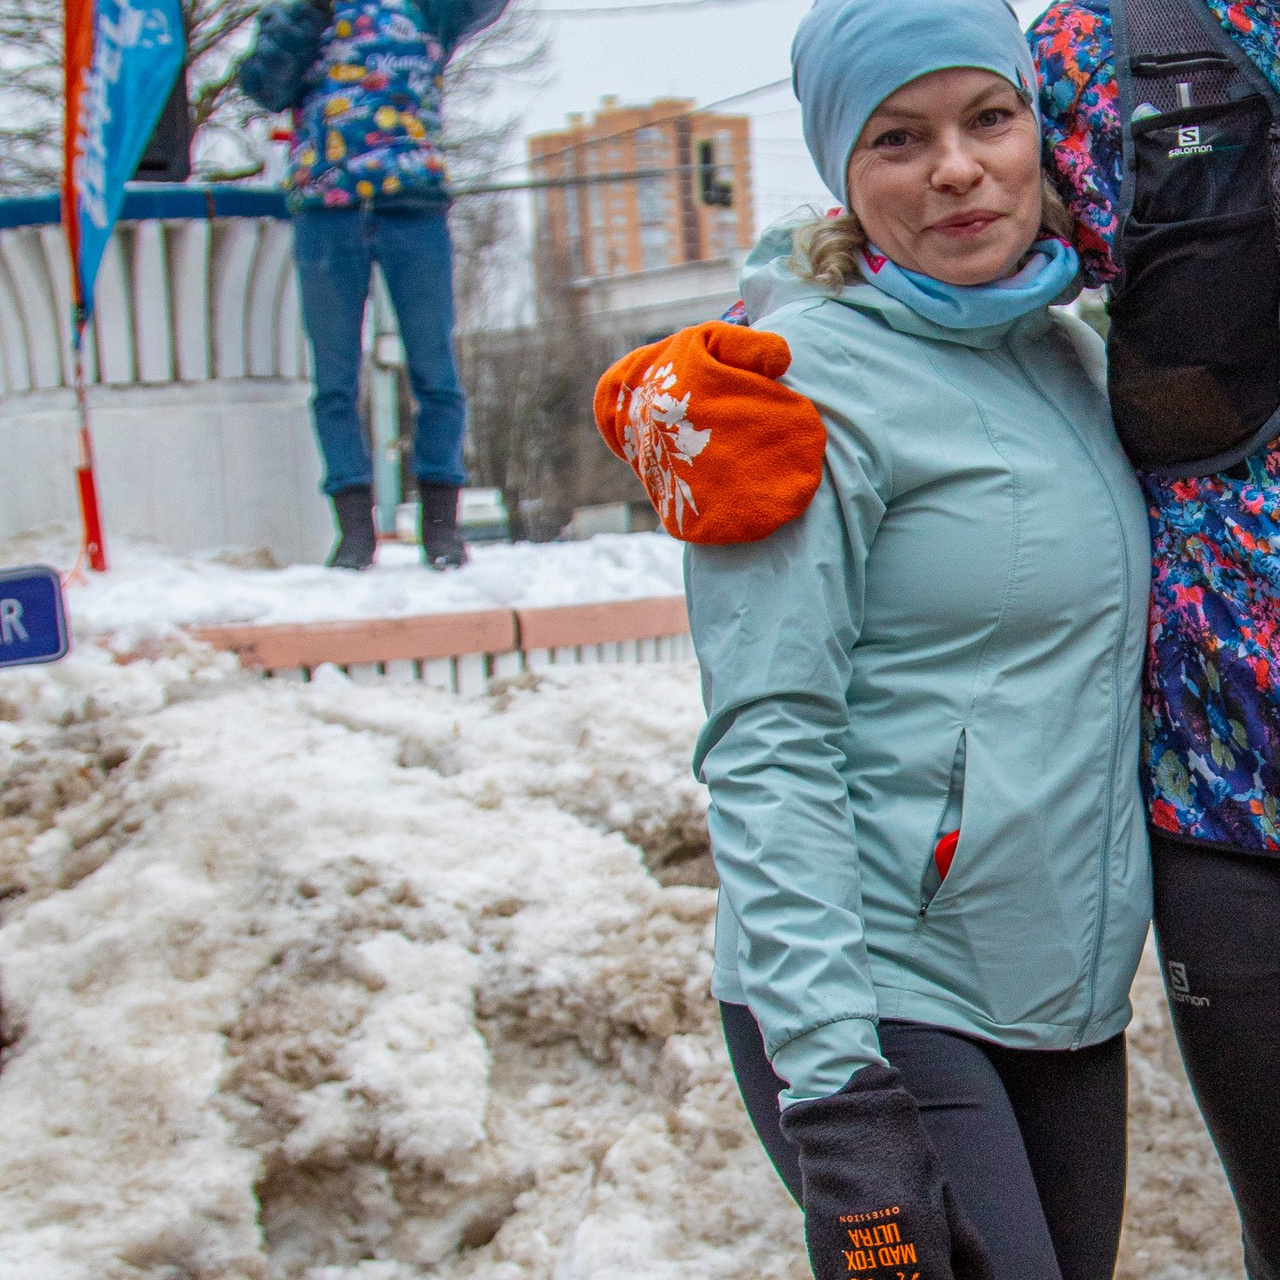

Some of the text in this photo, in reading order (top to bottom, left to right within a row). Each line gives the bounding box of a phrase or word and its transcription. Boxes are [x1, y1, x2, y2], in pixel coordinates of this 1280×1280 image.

[839, 1206, 900, 1223] OBSESSION
[847, 1222, 901, 1248] ULTRA
[844, 1242, 918, 1271] MAD FOX
